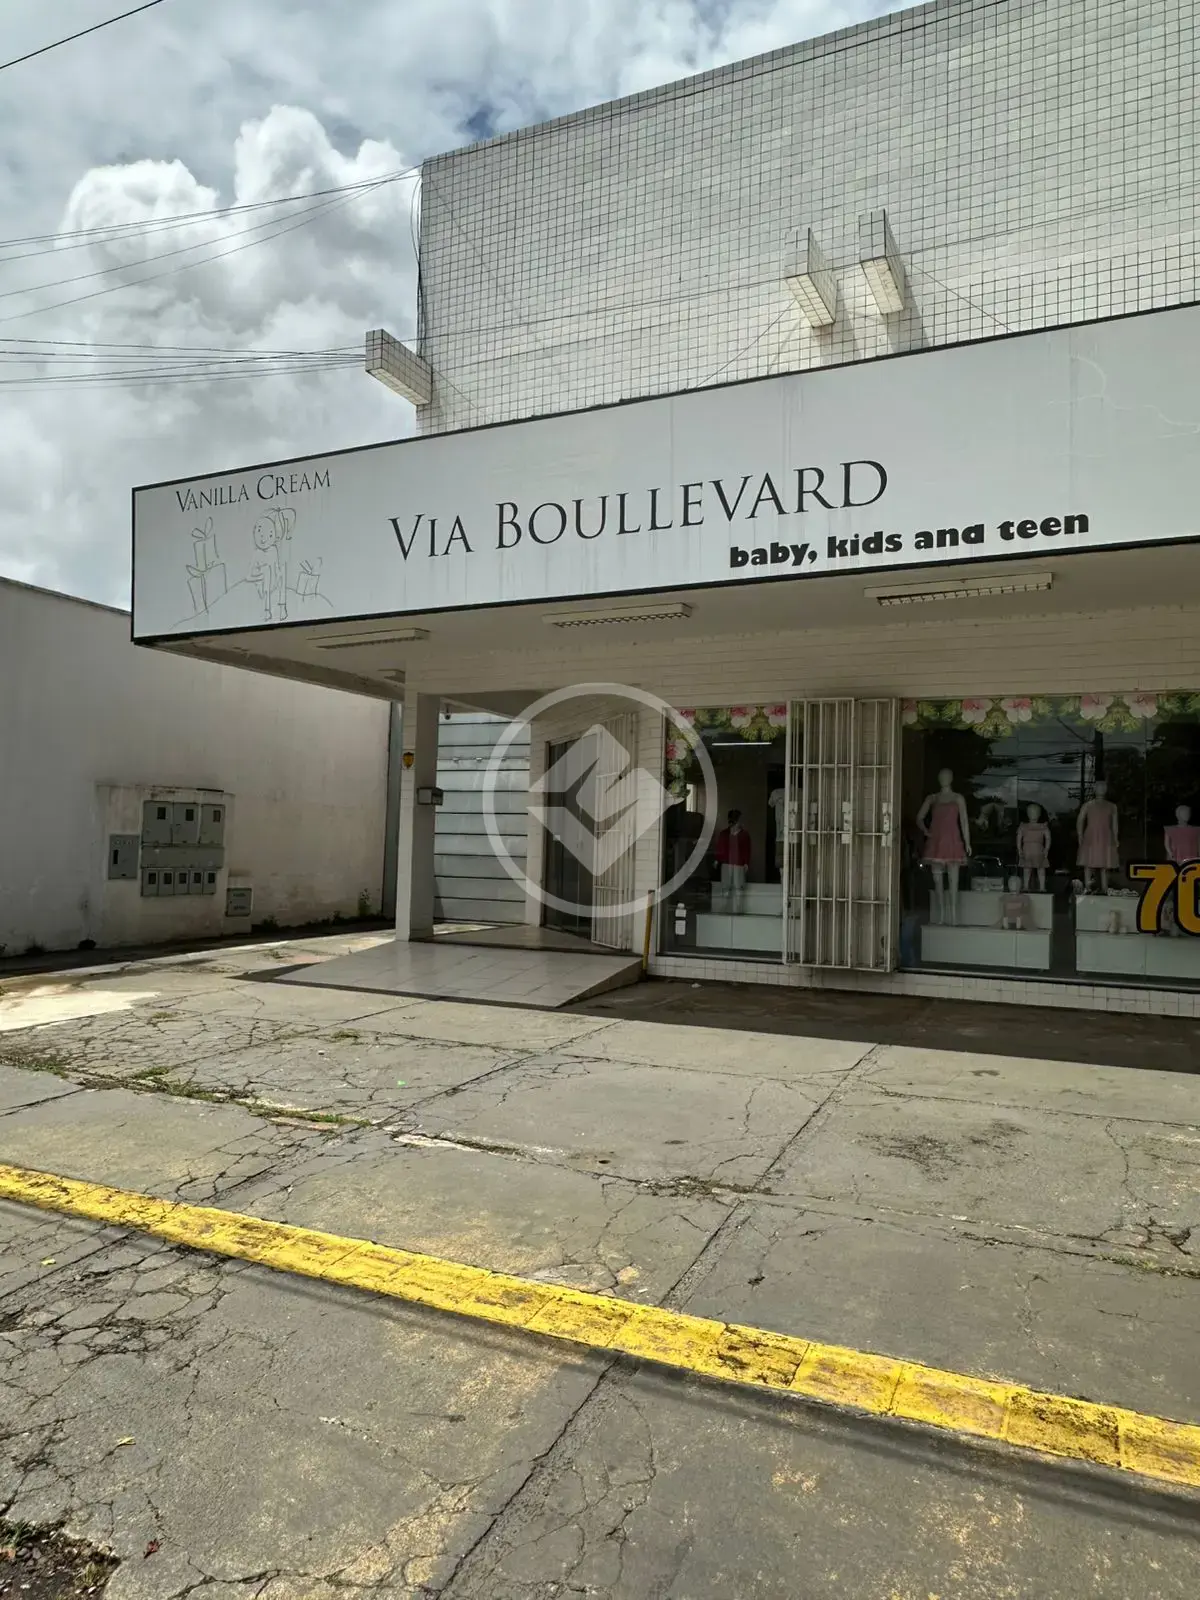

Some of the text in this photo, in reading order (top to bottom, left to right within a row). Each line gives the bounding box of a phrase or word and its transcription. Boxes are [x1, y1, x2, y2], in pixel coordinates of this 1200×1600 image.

[175, 468, 332, 513] VANILLA CREAM
[387, 459, 888, 561] VIA BOULLEVARD
[729, 513, 1090, 569] baby, kids and teen
